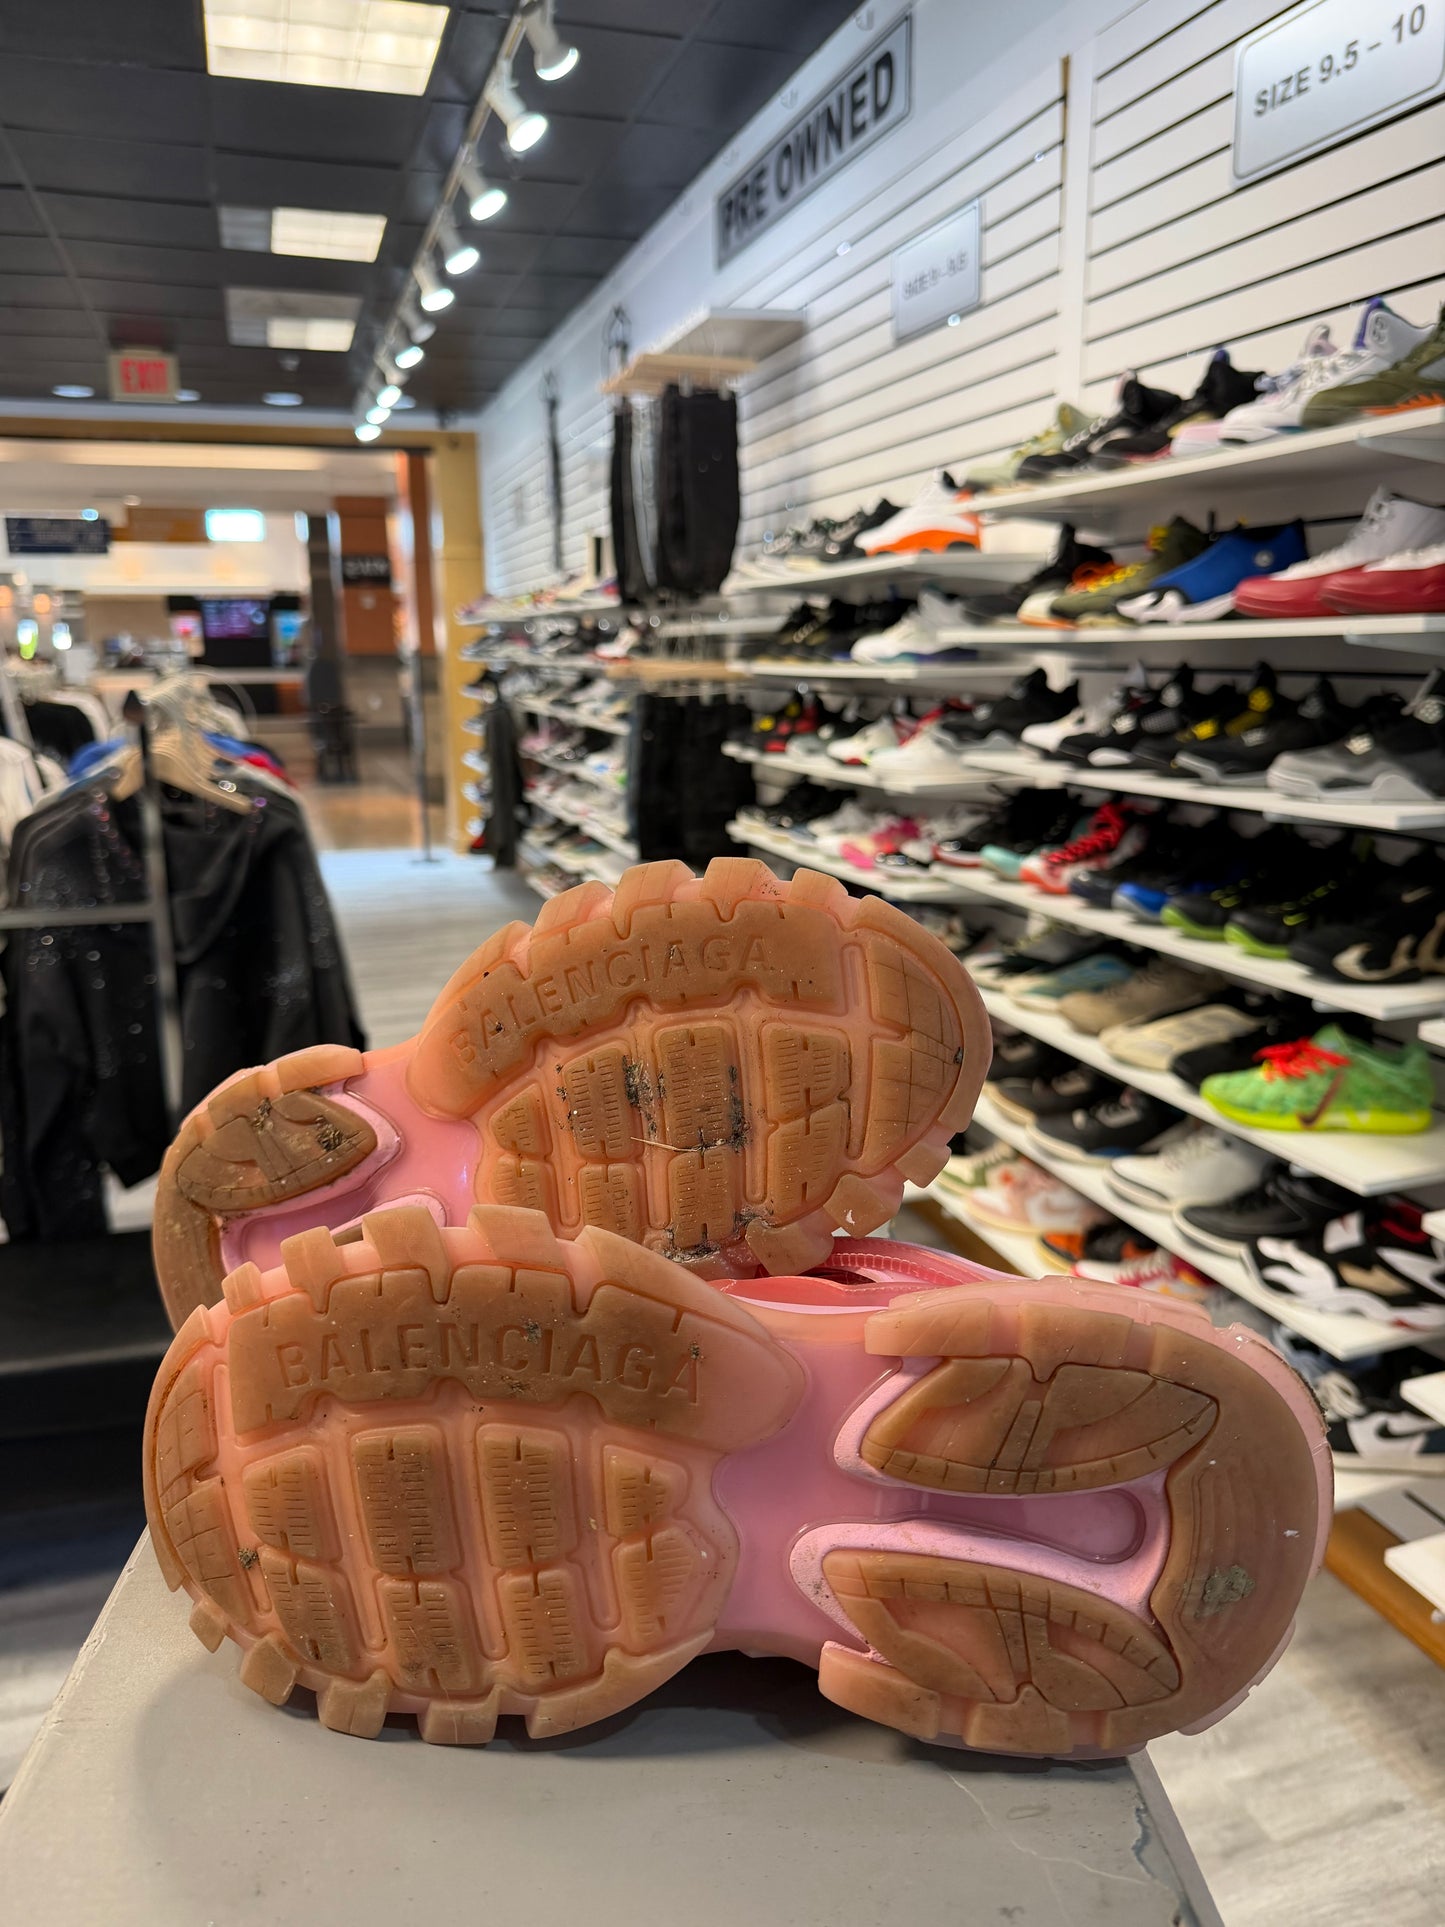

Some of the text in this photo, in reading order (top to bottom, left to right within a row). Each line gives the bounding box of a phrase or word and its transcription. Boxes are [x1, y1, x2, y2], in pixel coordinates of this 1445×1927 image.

[1254, 66, 1311, 117] SIZE
[1319, 40, 1359, 83] 9.5
[1392, 4, 1425, 43] 10
[720, 51, 893, 249] PRE OWNED
[121, 359, 168, 394] EXIT
[451, 934, 771, 1067] BALENCIAGA
[276, 1322, 699, 1404] BALENCIAGA
